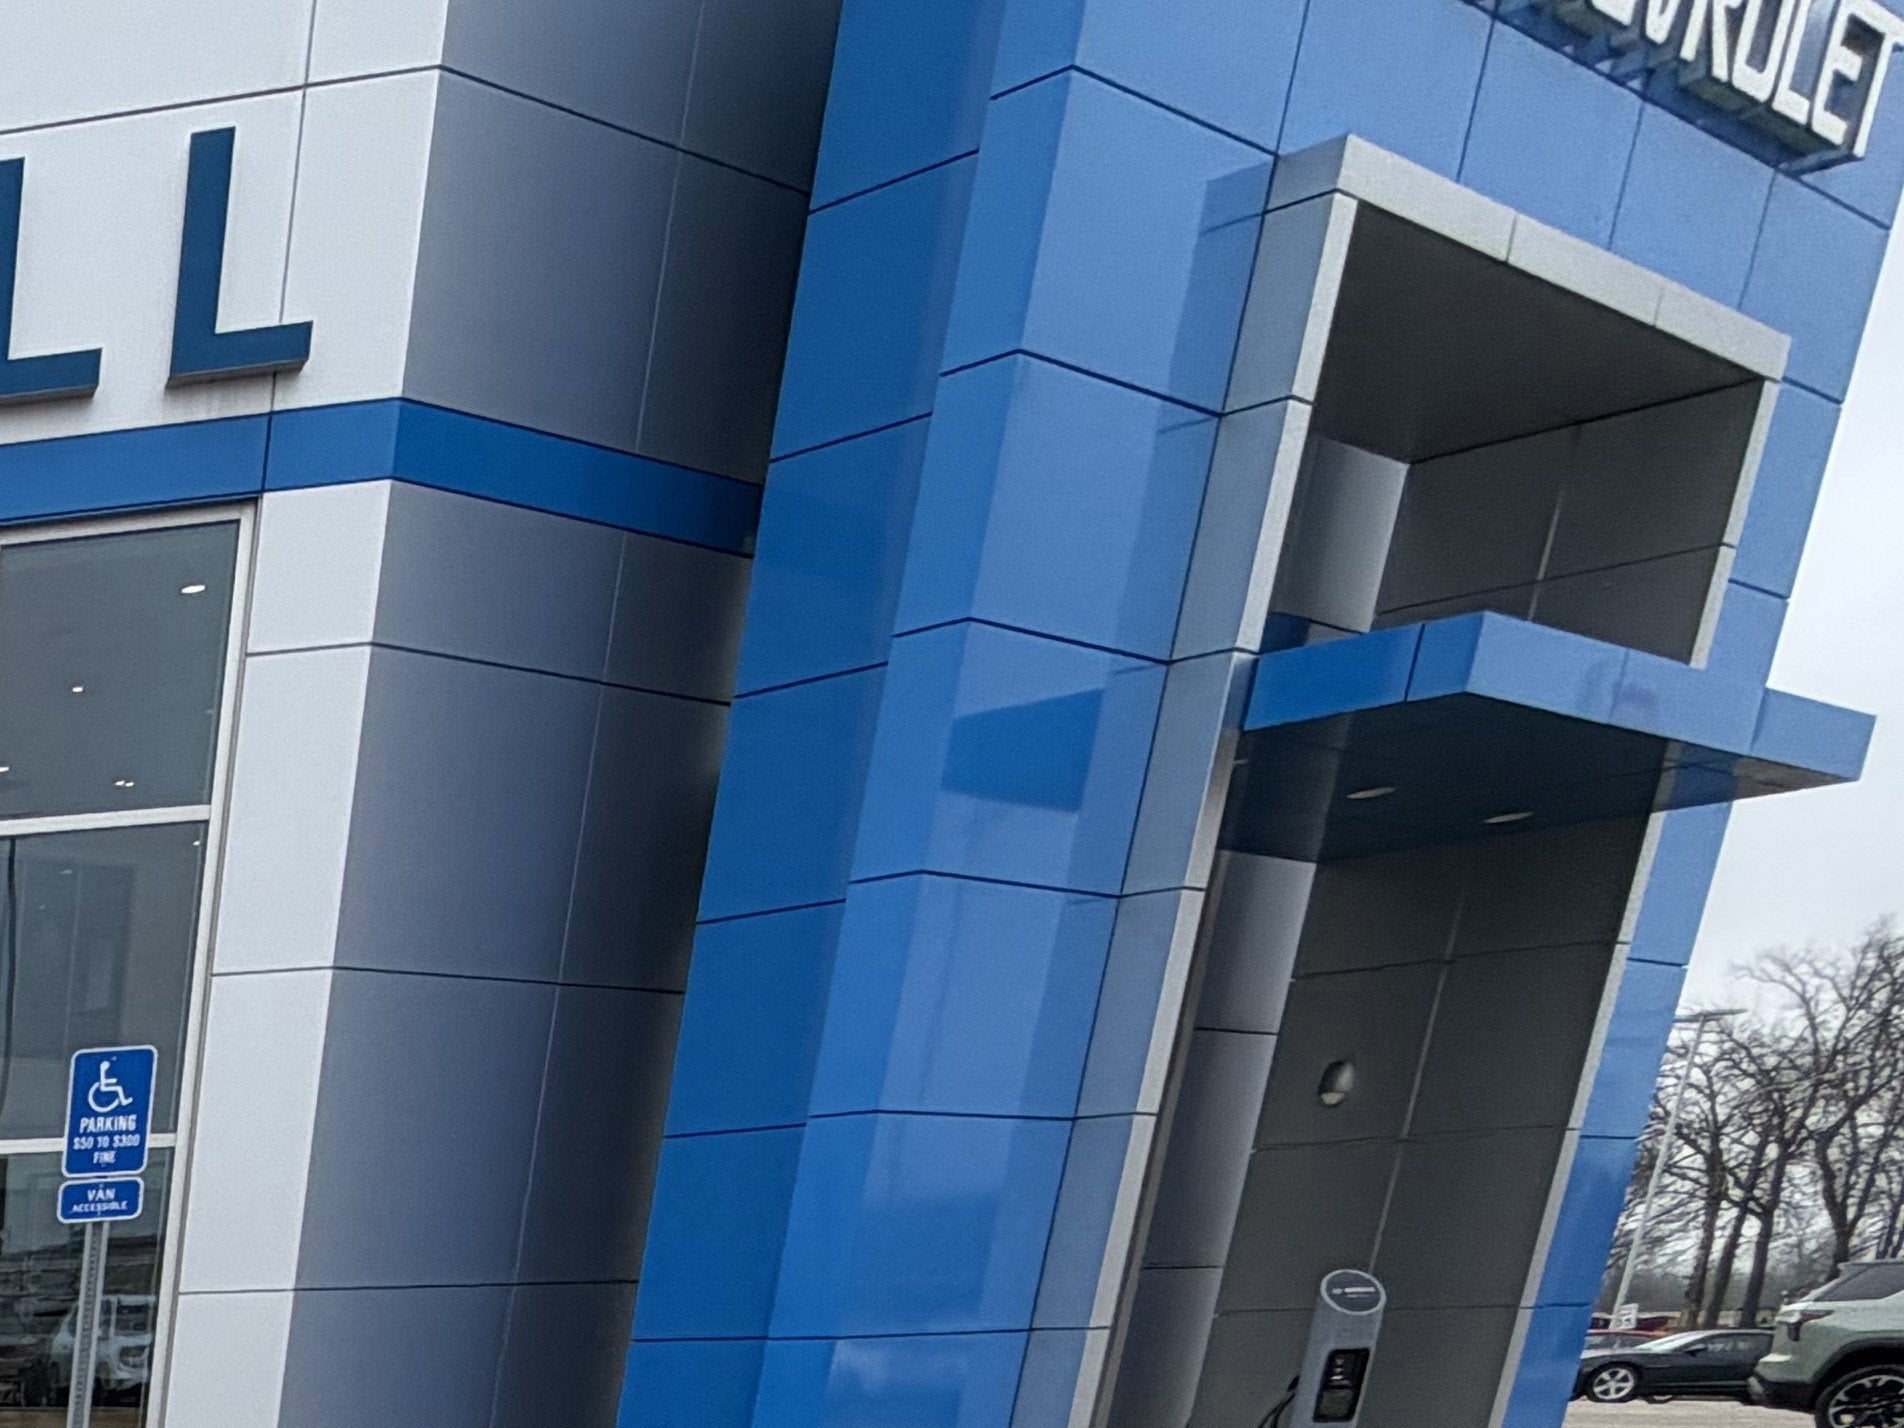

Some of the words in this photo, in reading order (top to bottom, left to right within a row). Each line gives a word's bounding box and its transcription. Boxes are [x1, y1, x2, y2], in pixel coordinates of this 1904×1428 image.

[79, 1114, 137, 1134] PARKING
[73, 1137, 93, 1150] $50
[97, 1135, 110, 1148] TO
[93, 1150, 116, 1164] FINE
[87, 1188, 116, 1200] VAN
